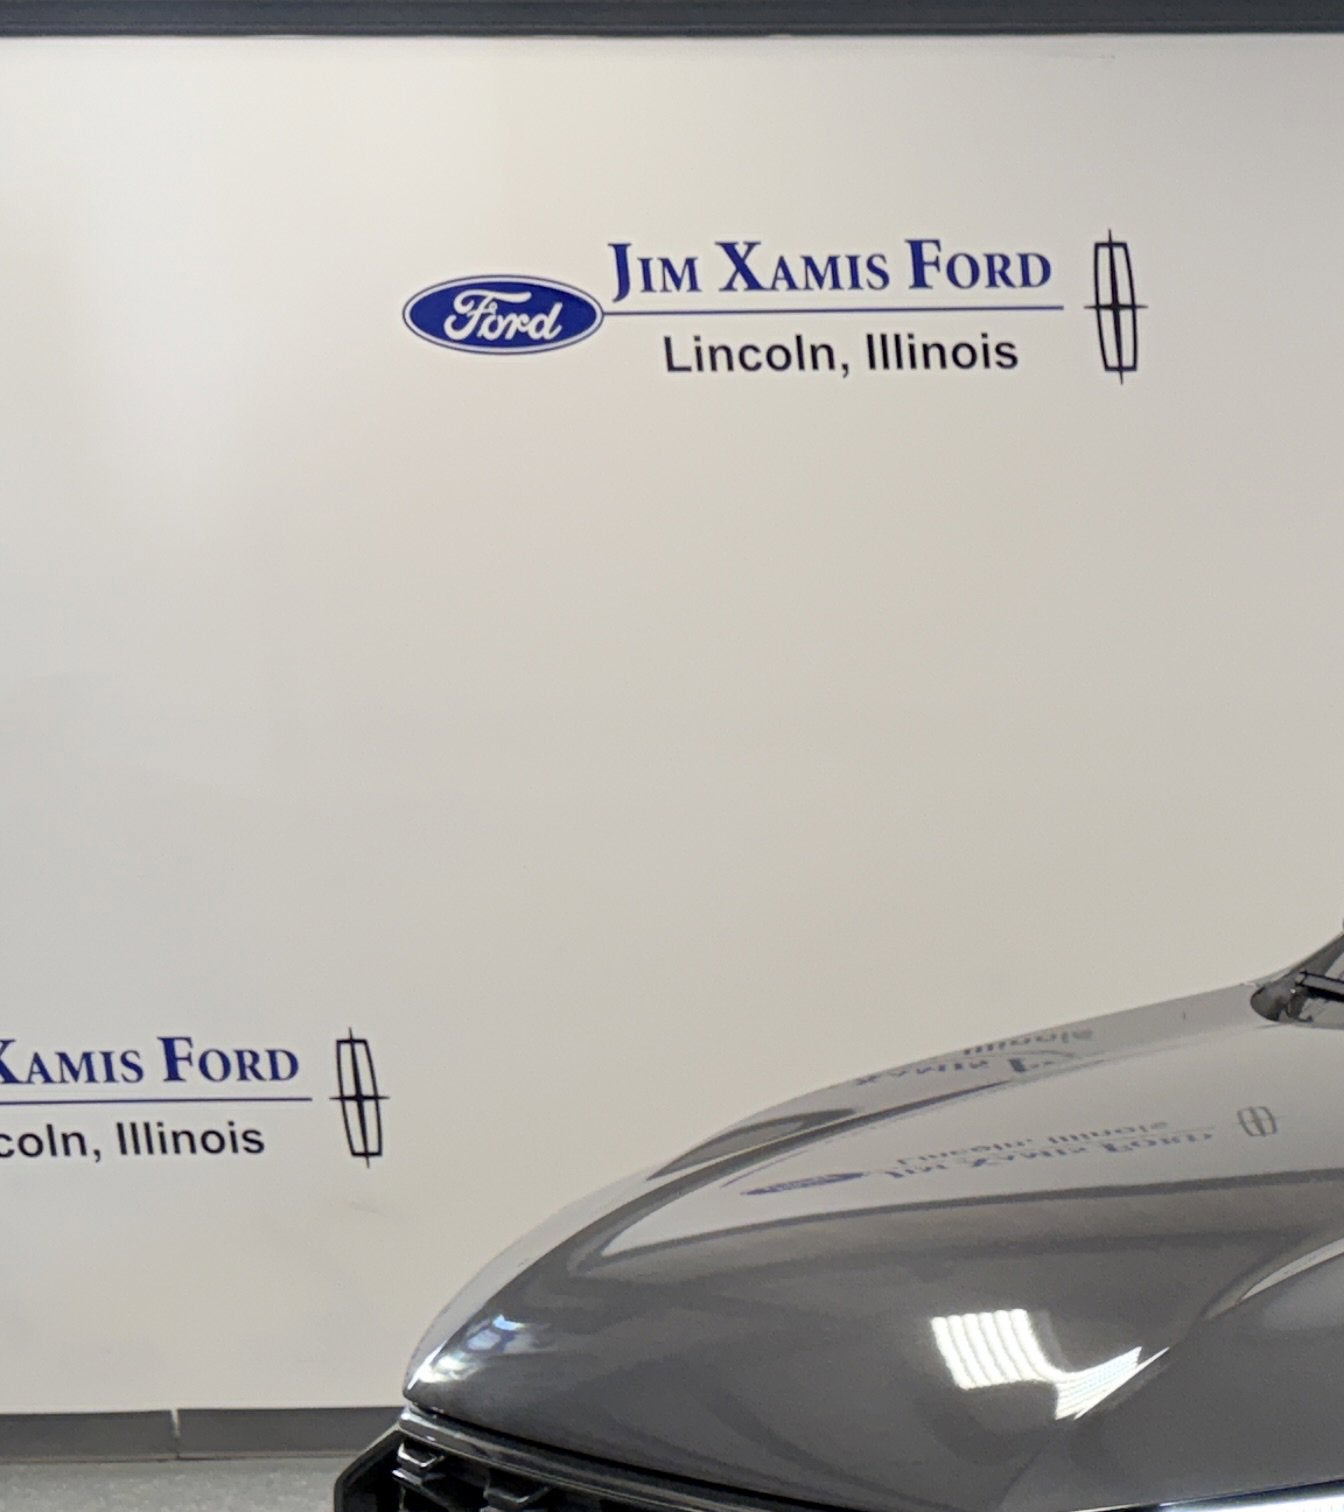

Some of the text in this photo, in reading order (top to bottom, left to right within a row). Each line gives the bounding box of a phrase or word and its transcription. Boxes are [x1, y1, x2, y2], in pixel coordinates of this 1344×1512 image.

[608, 239, 1052, 303] JIM XAMIS FORD
[443, 290, 563, 342] Ford
[664, 332, 1018, 378] Lincoln, Illinois
[157, 1036, 299, 1083] FORD
[116, 1120, 266, 1155] Illinois
